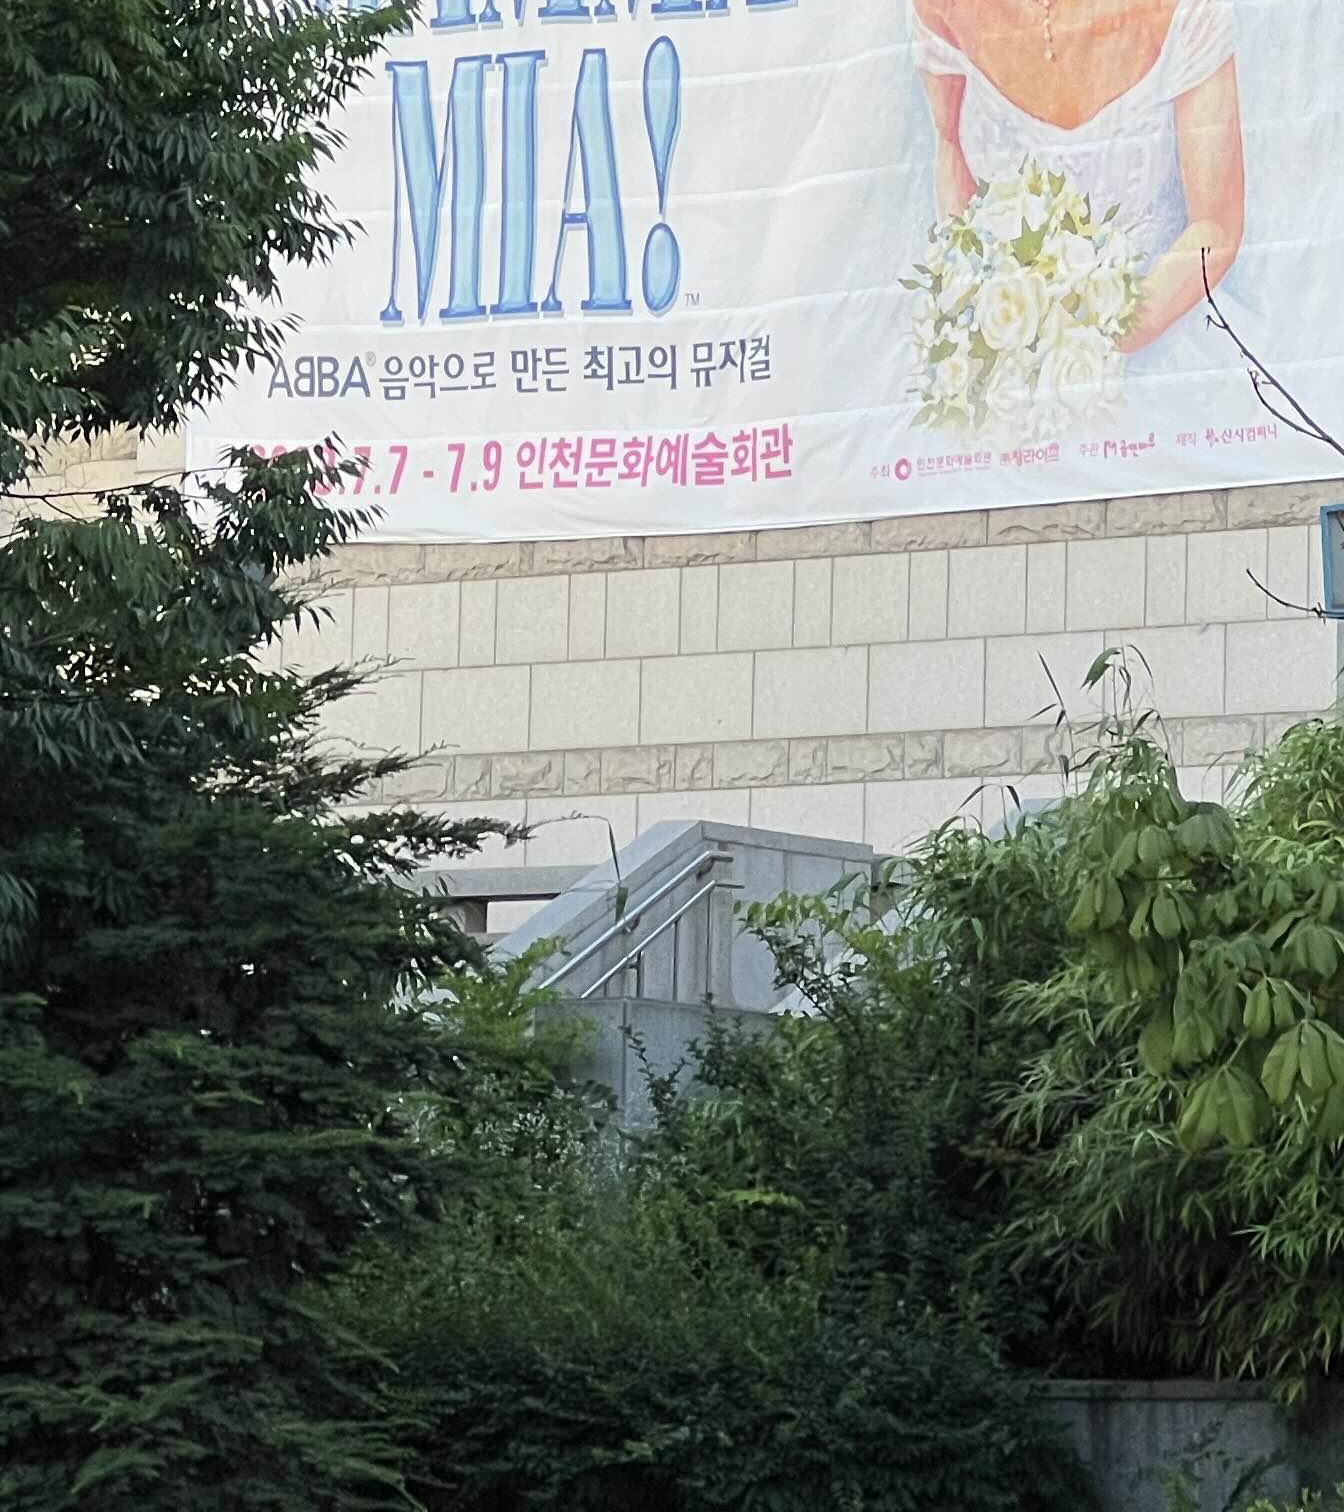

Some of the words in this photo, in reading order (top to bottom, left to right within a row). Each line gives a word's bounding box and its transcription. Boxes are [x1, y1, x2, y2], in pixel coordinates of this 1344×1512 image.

[380, 35, 681, 324] MIA!
[379, 351, 496, 401] 음악으로
[511, 348, 569, 393] 만든
[583, 344, 677, 391] 최고의
[690, 335, 771, 388] 뮤지컬
[447, 440, 503, 493] 7.9
[516, 423, 793, 490] 인천문화예술회관
